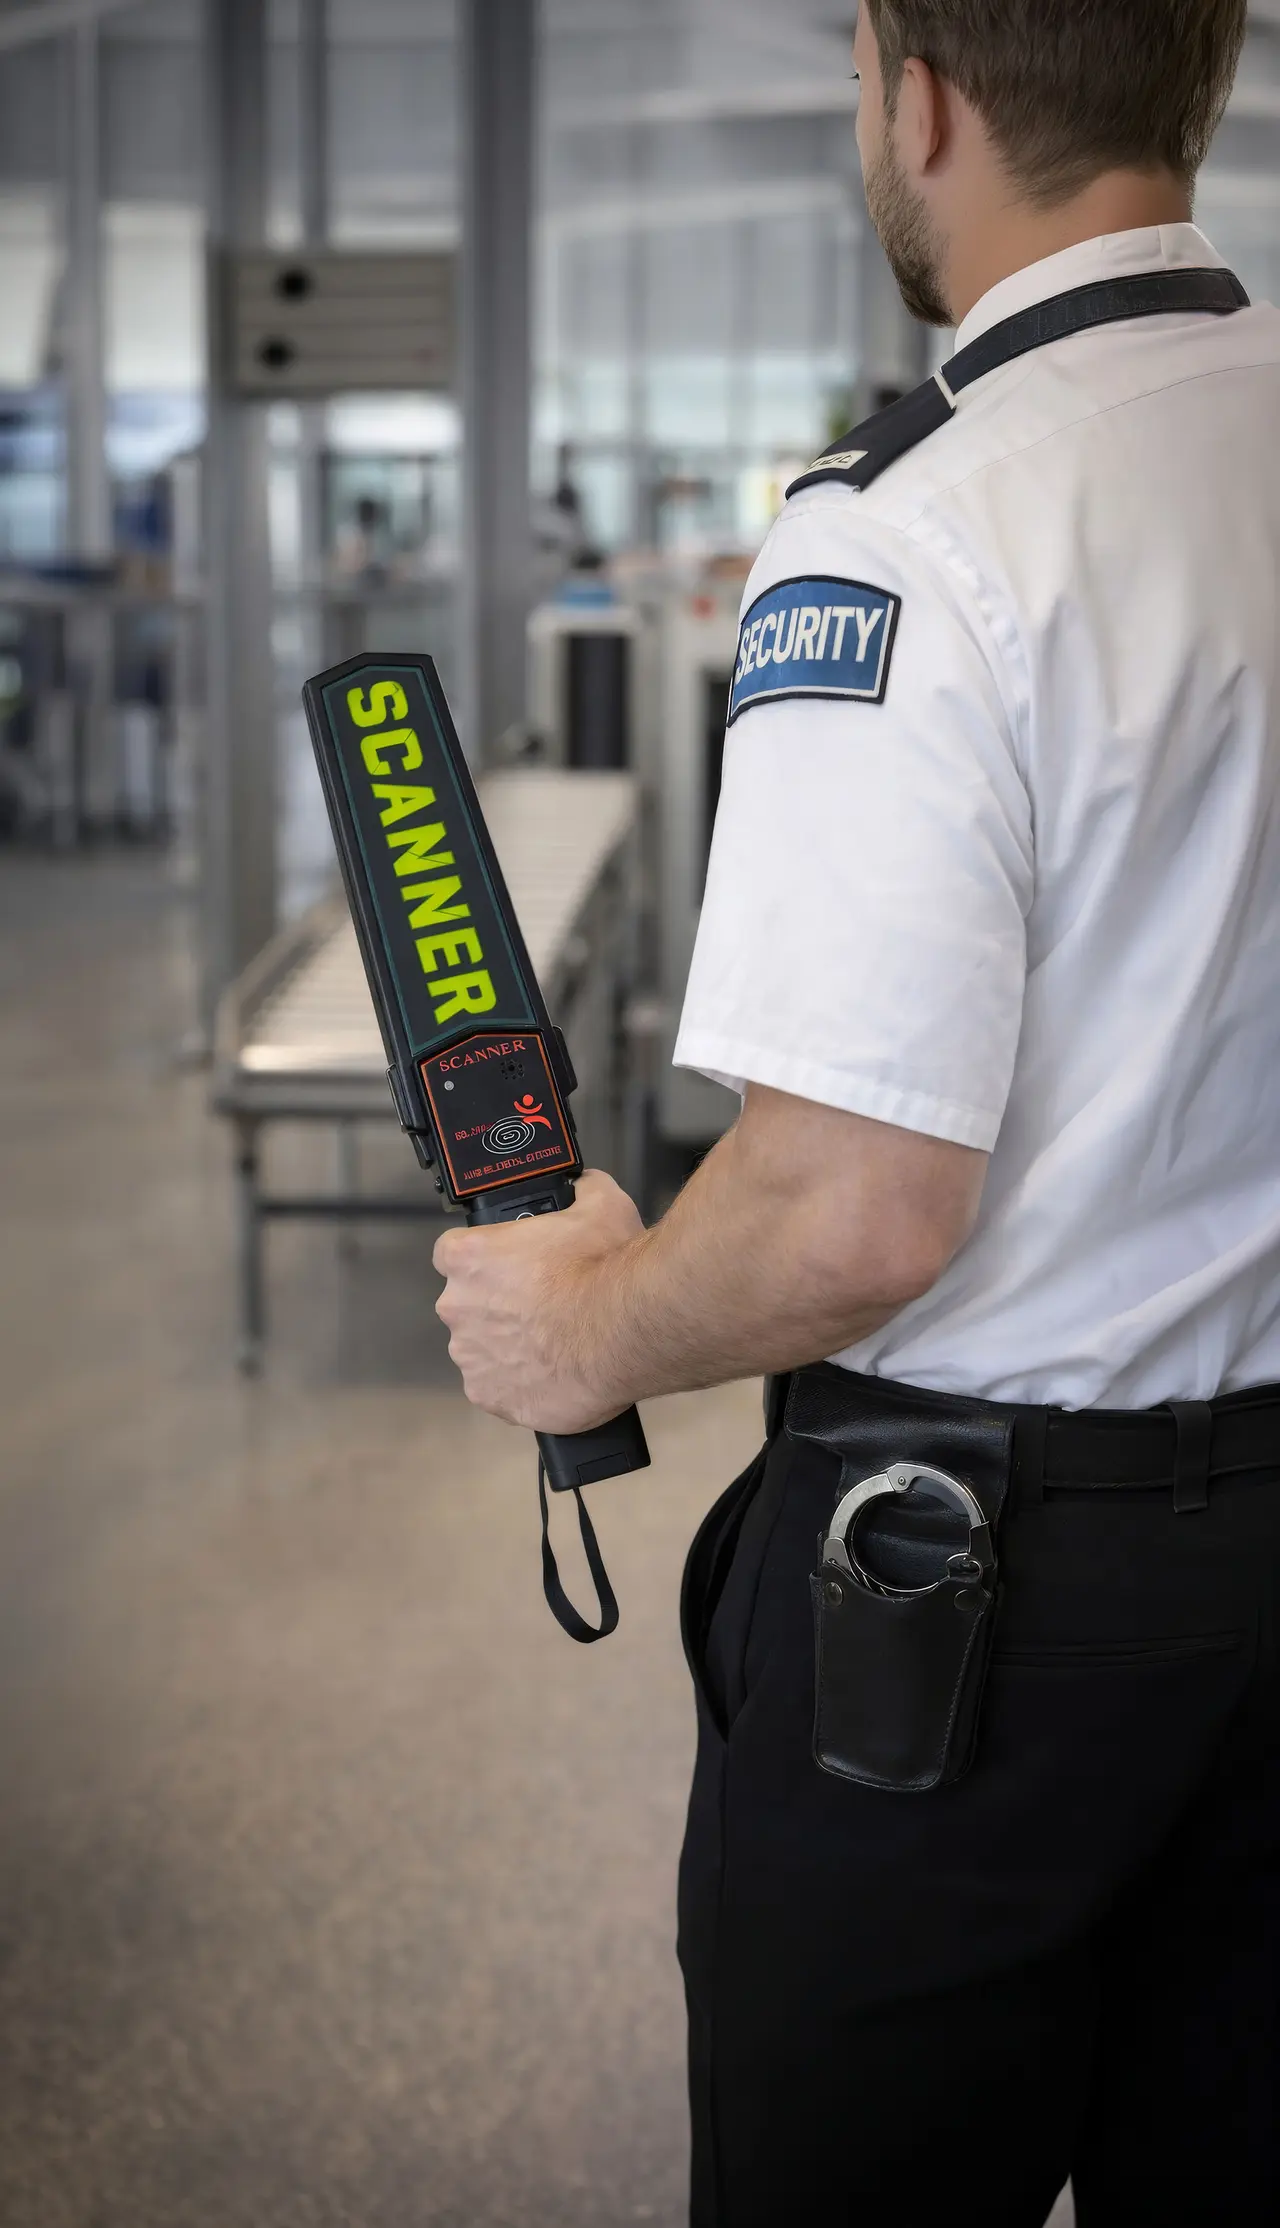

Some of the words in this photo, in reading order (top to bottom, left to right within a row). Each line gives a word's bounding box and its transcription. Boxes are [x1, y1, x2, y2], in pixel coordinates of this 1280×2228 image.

[735, 606, 884, 685] SECURITY
[346, 680, 498, 1025] SCANNER
[439, 1039, 526, 1072] SCANNER
